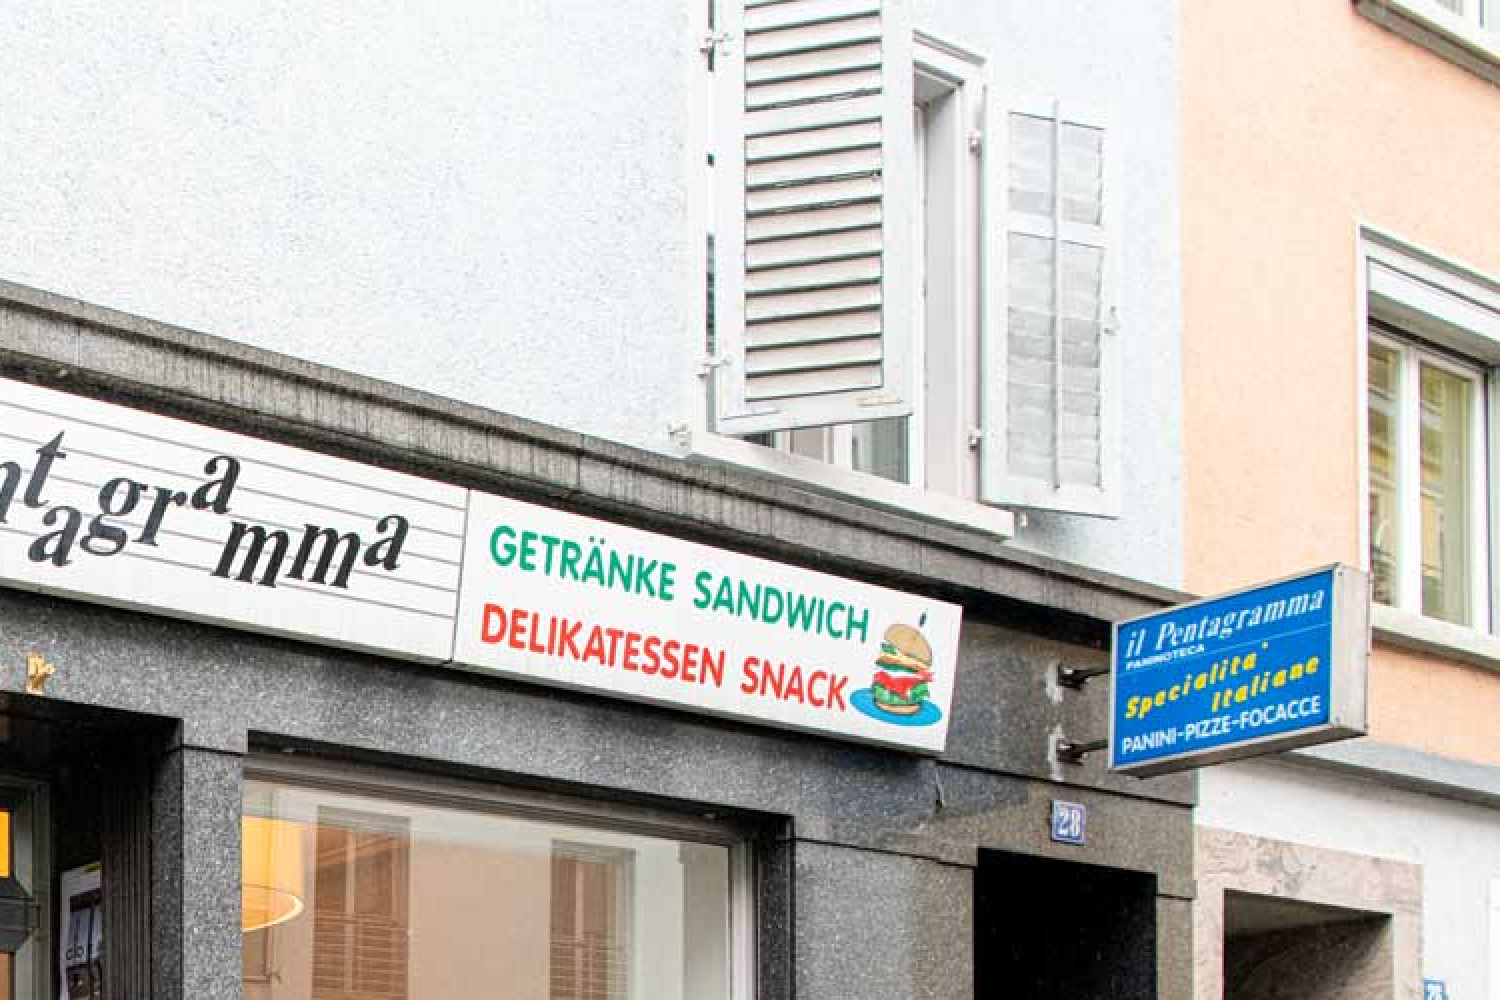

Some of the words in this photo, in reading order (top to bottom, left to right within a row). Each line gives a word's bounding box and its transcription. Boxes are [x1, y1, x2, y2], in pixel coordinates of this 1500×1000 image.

[488, 524, 676, 602] GETRÄNKE
[692, 569, 871, 643] SANDWICH
[1126, 629, 1147, 659] il
[1155, 589, 1325, 651] Pentagramma
[480, 602, 725, 687] DELIKATESSEN
[740, 656, 849, 712] SNACK
[1210, 656, 1320, 713] Italiane
[1121, 695, 1322, 755] PANINI-PIZZE-FOCACCE
[1057, 811, 1081, 837] 28
